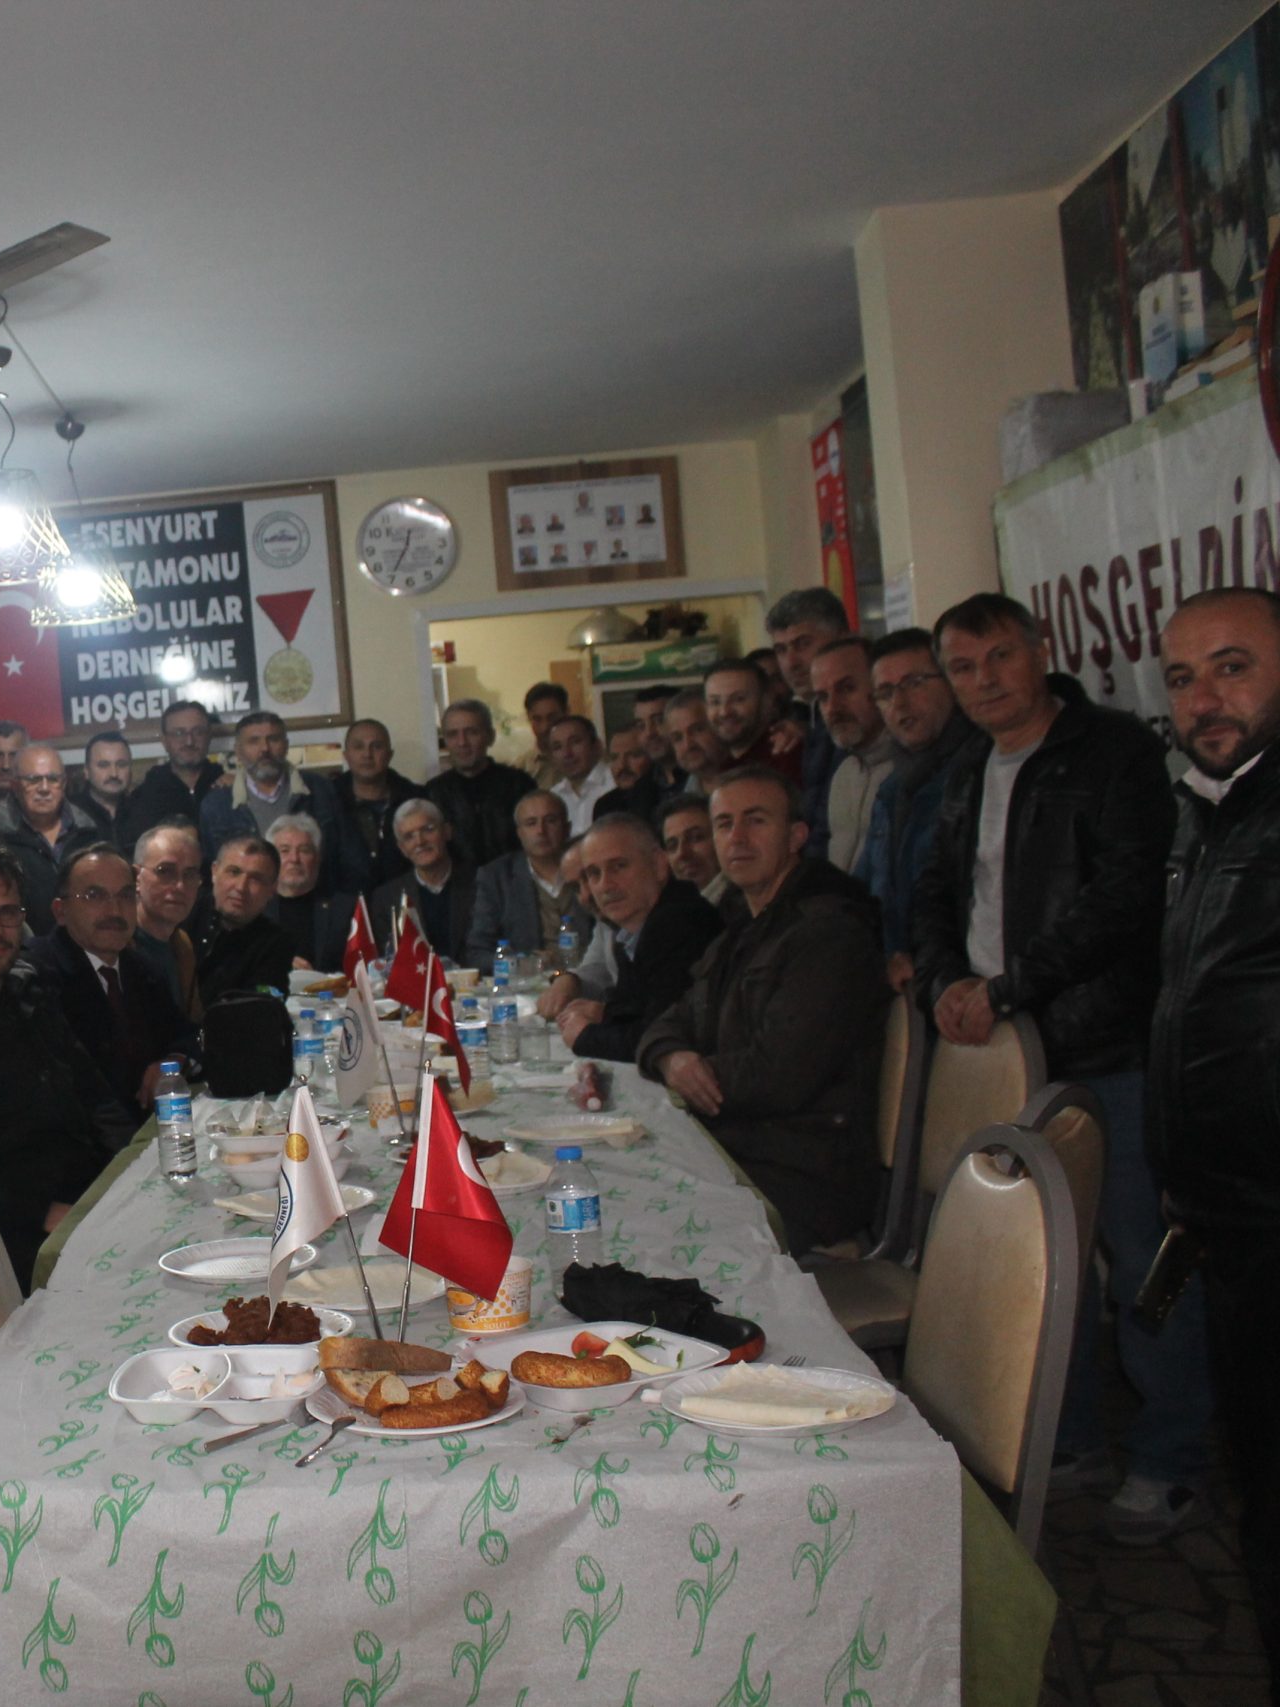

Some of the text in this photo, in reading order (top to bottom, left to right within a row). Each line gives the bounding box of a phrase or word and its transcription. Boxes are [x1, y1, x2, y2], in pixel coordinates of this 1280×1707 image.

[79, 510, 218, 549] ESENYURT
[370, 527, 381, 539] 10
[388, 574, 395, 584] 7
[405, 576, 415, 587] 6
